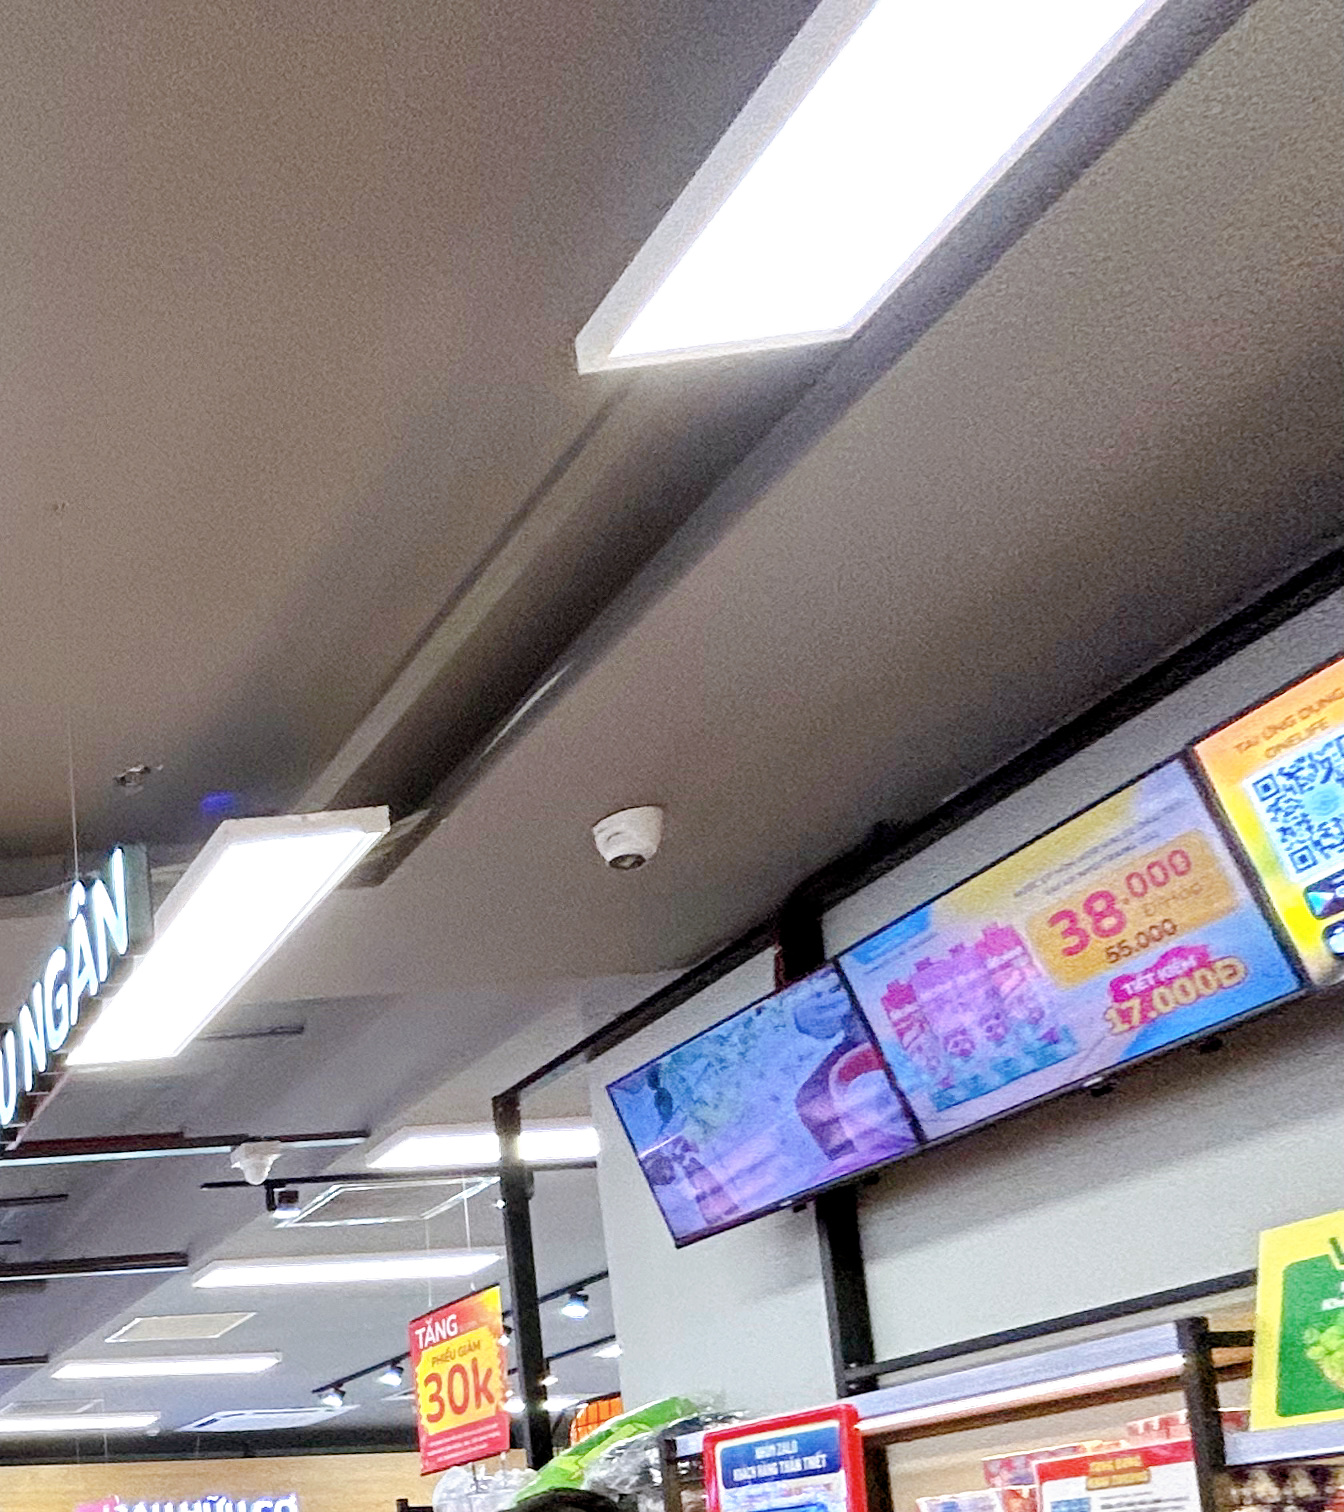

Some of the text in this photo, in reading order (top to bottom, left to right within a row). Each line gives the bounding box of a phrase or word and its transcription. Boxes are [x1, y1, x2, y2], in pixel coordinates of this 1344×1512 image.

[1046, 848, 1192, 957] 38.000
[1104, 918, 1178, 964] 55.000
[18, 846, 130, 1092] NGÂN
[424, 1356, 495, 1423] 30k
